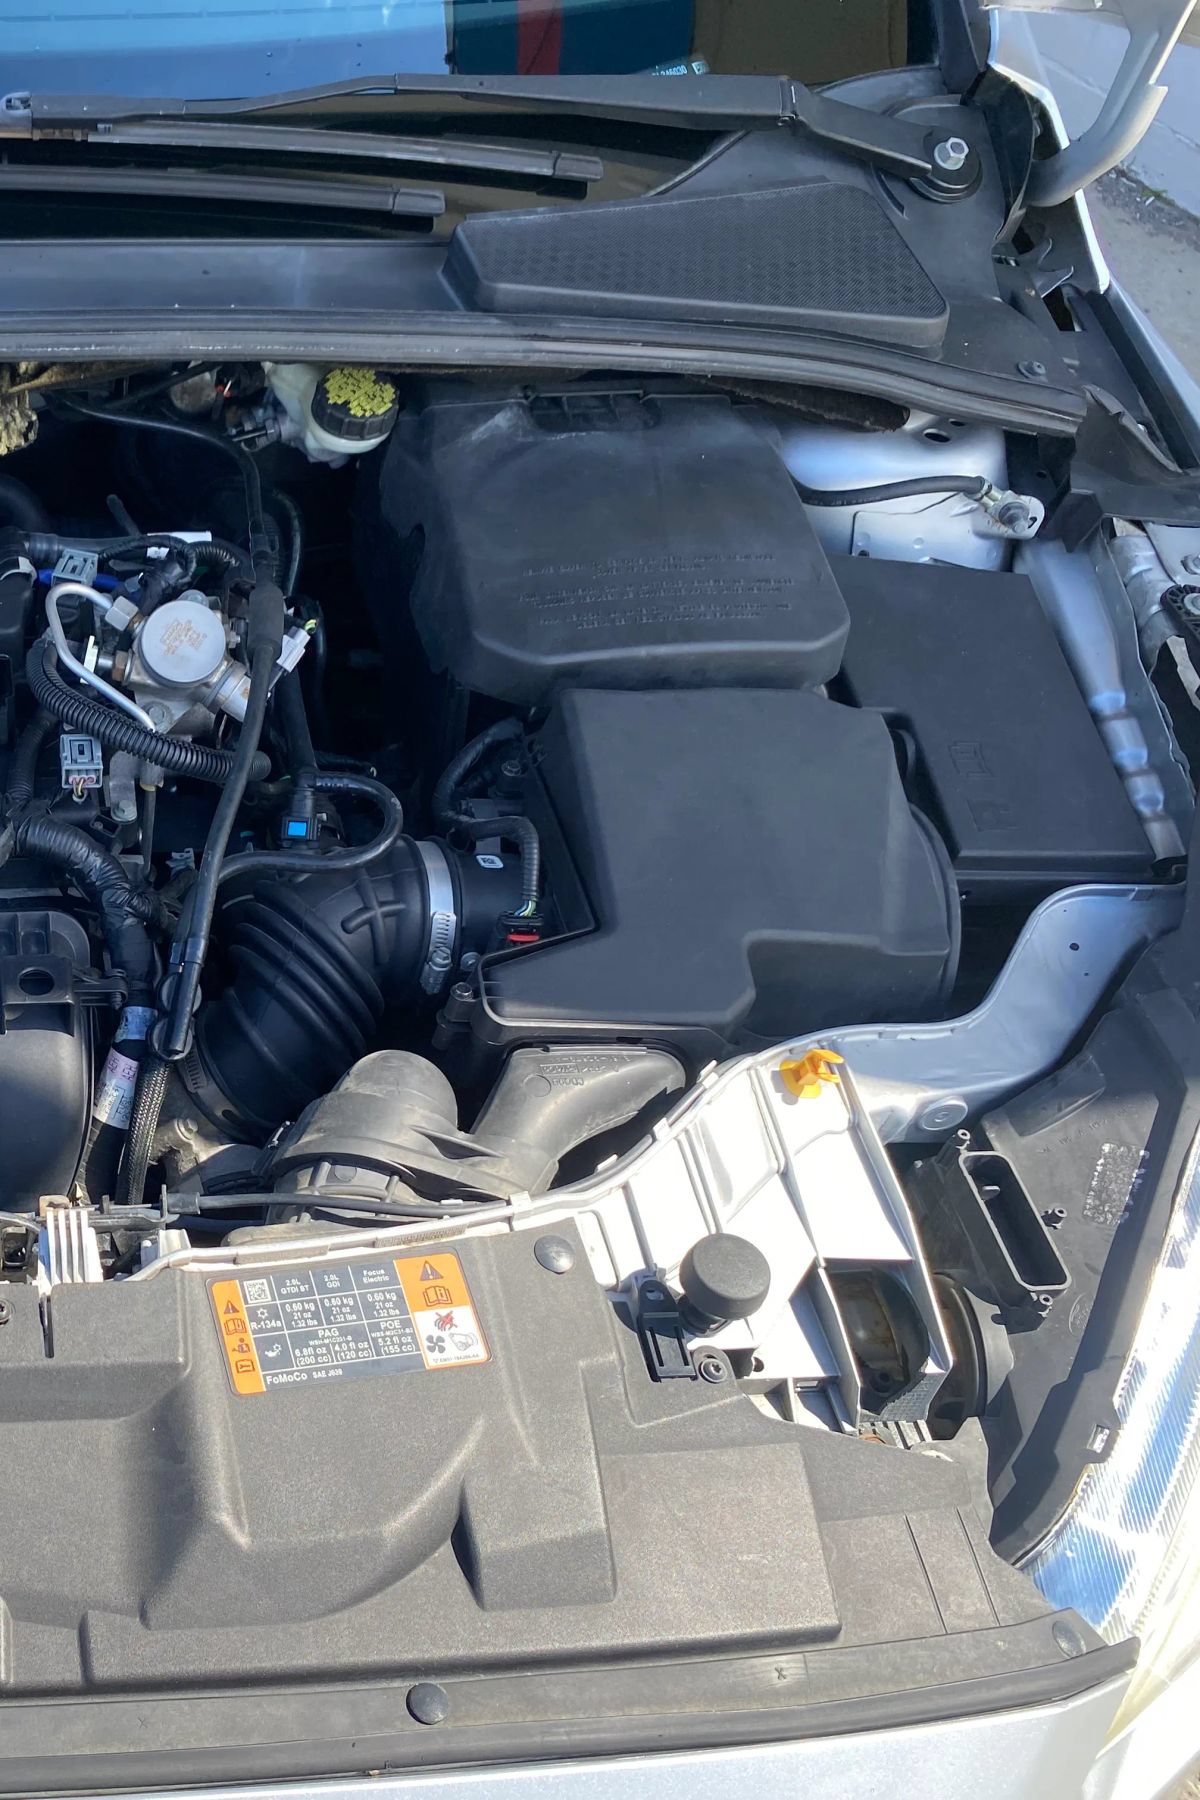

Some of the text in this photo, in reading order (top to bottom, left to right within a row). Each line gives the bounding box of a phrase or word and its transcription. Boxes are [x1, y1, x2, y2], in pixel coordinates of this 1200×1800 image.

[285, 1278, 301, 1286] 2.0L
[363, 1275, 390, 1284] Electric
[367, 1291, 397, 1301] 0.60 kg
[285, 1301, 316, 1312] 0.60 kg
[323, 1296, 354, 1307] 0.60 kg
[293, 1311, 312, 1320] 21 oz
[330, 1313, 357, 1323] 1.32 lbs
[373, 1308, 400, 1318] 1.32 lbs
[251, 1320, 282, 1331] R-134a
[291, 1318, 318, 1328] 1.32 lbs
[380, 1320, 402, 1330] POE
[318, 1328, 339, 1338] PAG
[378, 1335, 413, 1346] 5.2 fl oz
[316, 1346, 327, 1354] oz
[334, 1341, 369, 1351] 4.0 fl oz
[381, 1342, 416, 1356] (155 cc)
[337, 1348, 373, 1361] (120 cc)
[296, 1353, 332, 1367] (200 cc)
[266, 1371, 308, 1385] FoMoCo
[312, 1370, 327, 1379] SAE
